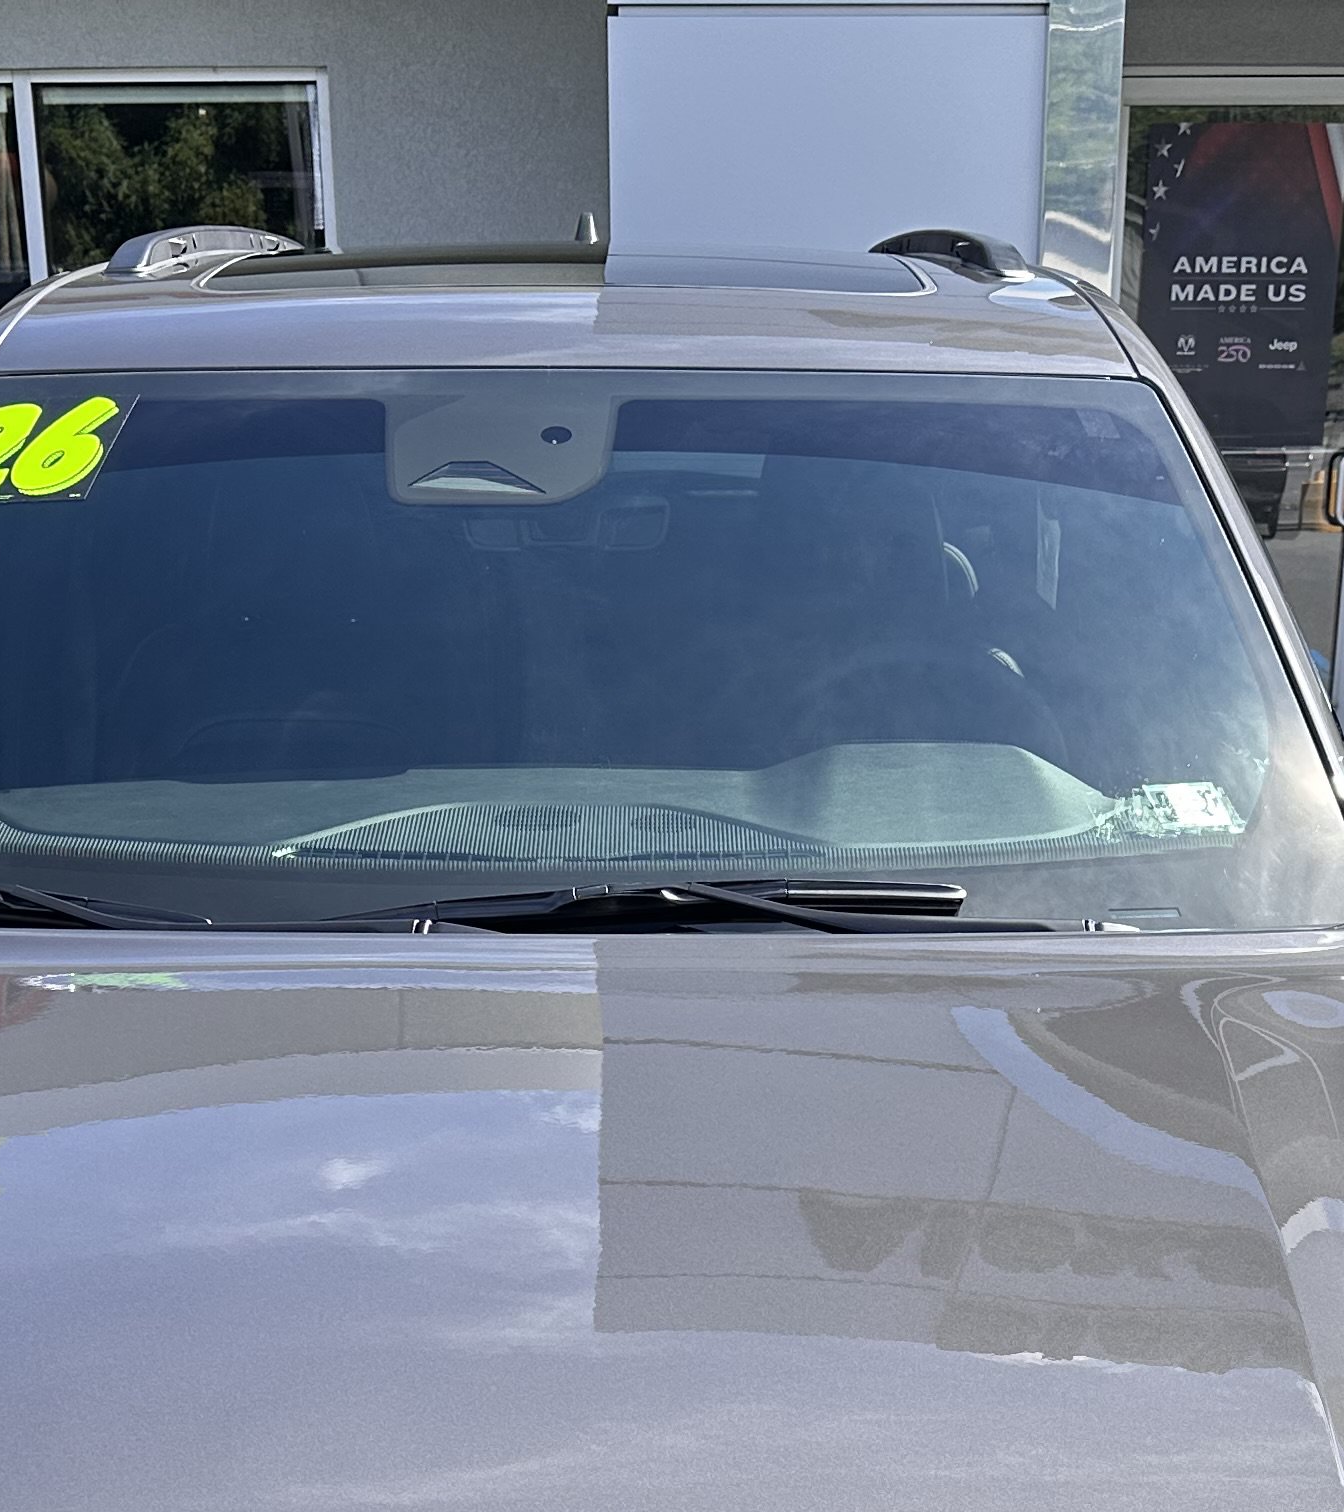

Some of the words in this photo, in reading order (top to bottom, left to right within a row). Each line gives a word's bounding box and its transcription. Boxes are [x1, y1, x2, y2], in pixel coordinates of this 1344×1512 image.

[1173, 256, 1308, 274] AMERICA
[1170, 284, 1256, 301] MADE
[1267, 284, 1306, 302] US
[1219, 336, 1251, 344] AMERICA
[1269, 339, 1298, 352] Jeep
[1217, 345, 1251, 362] 250
